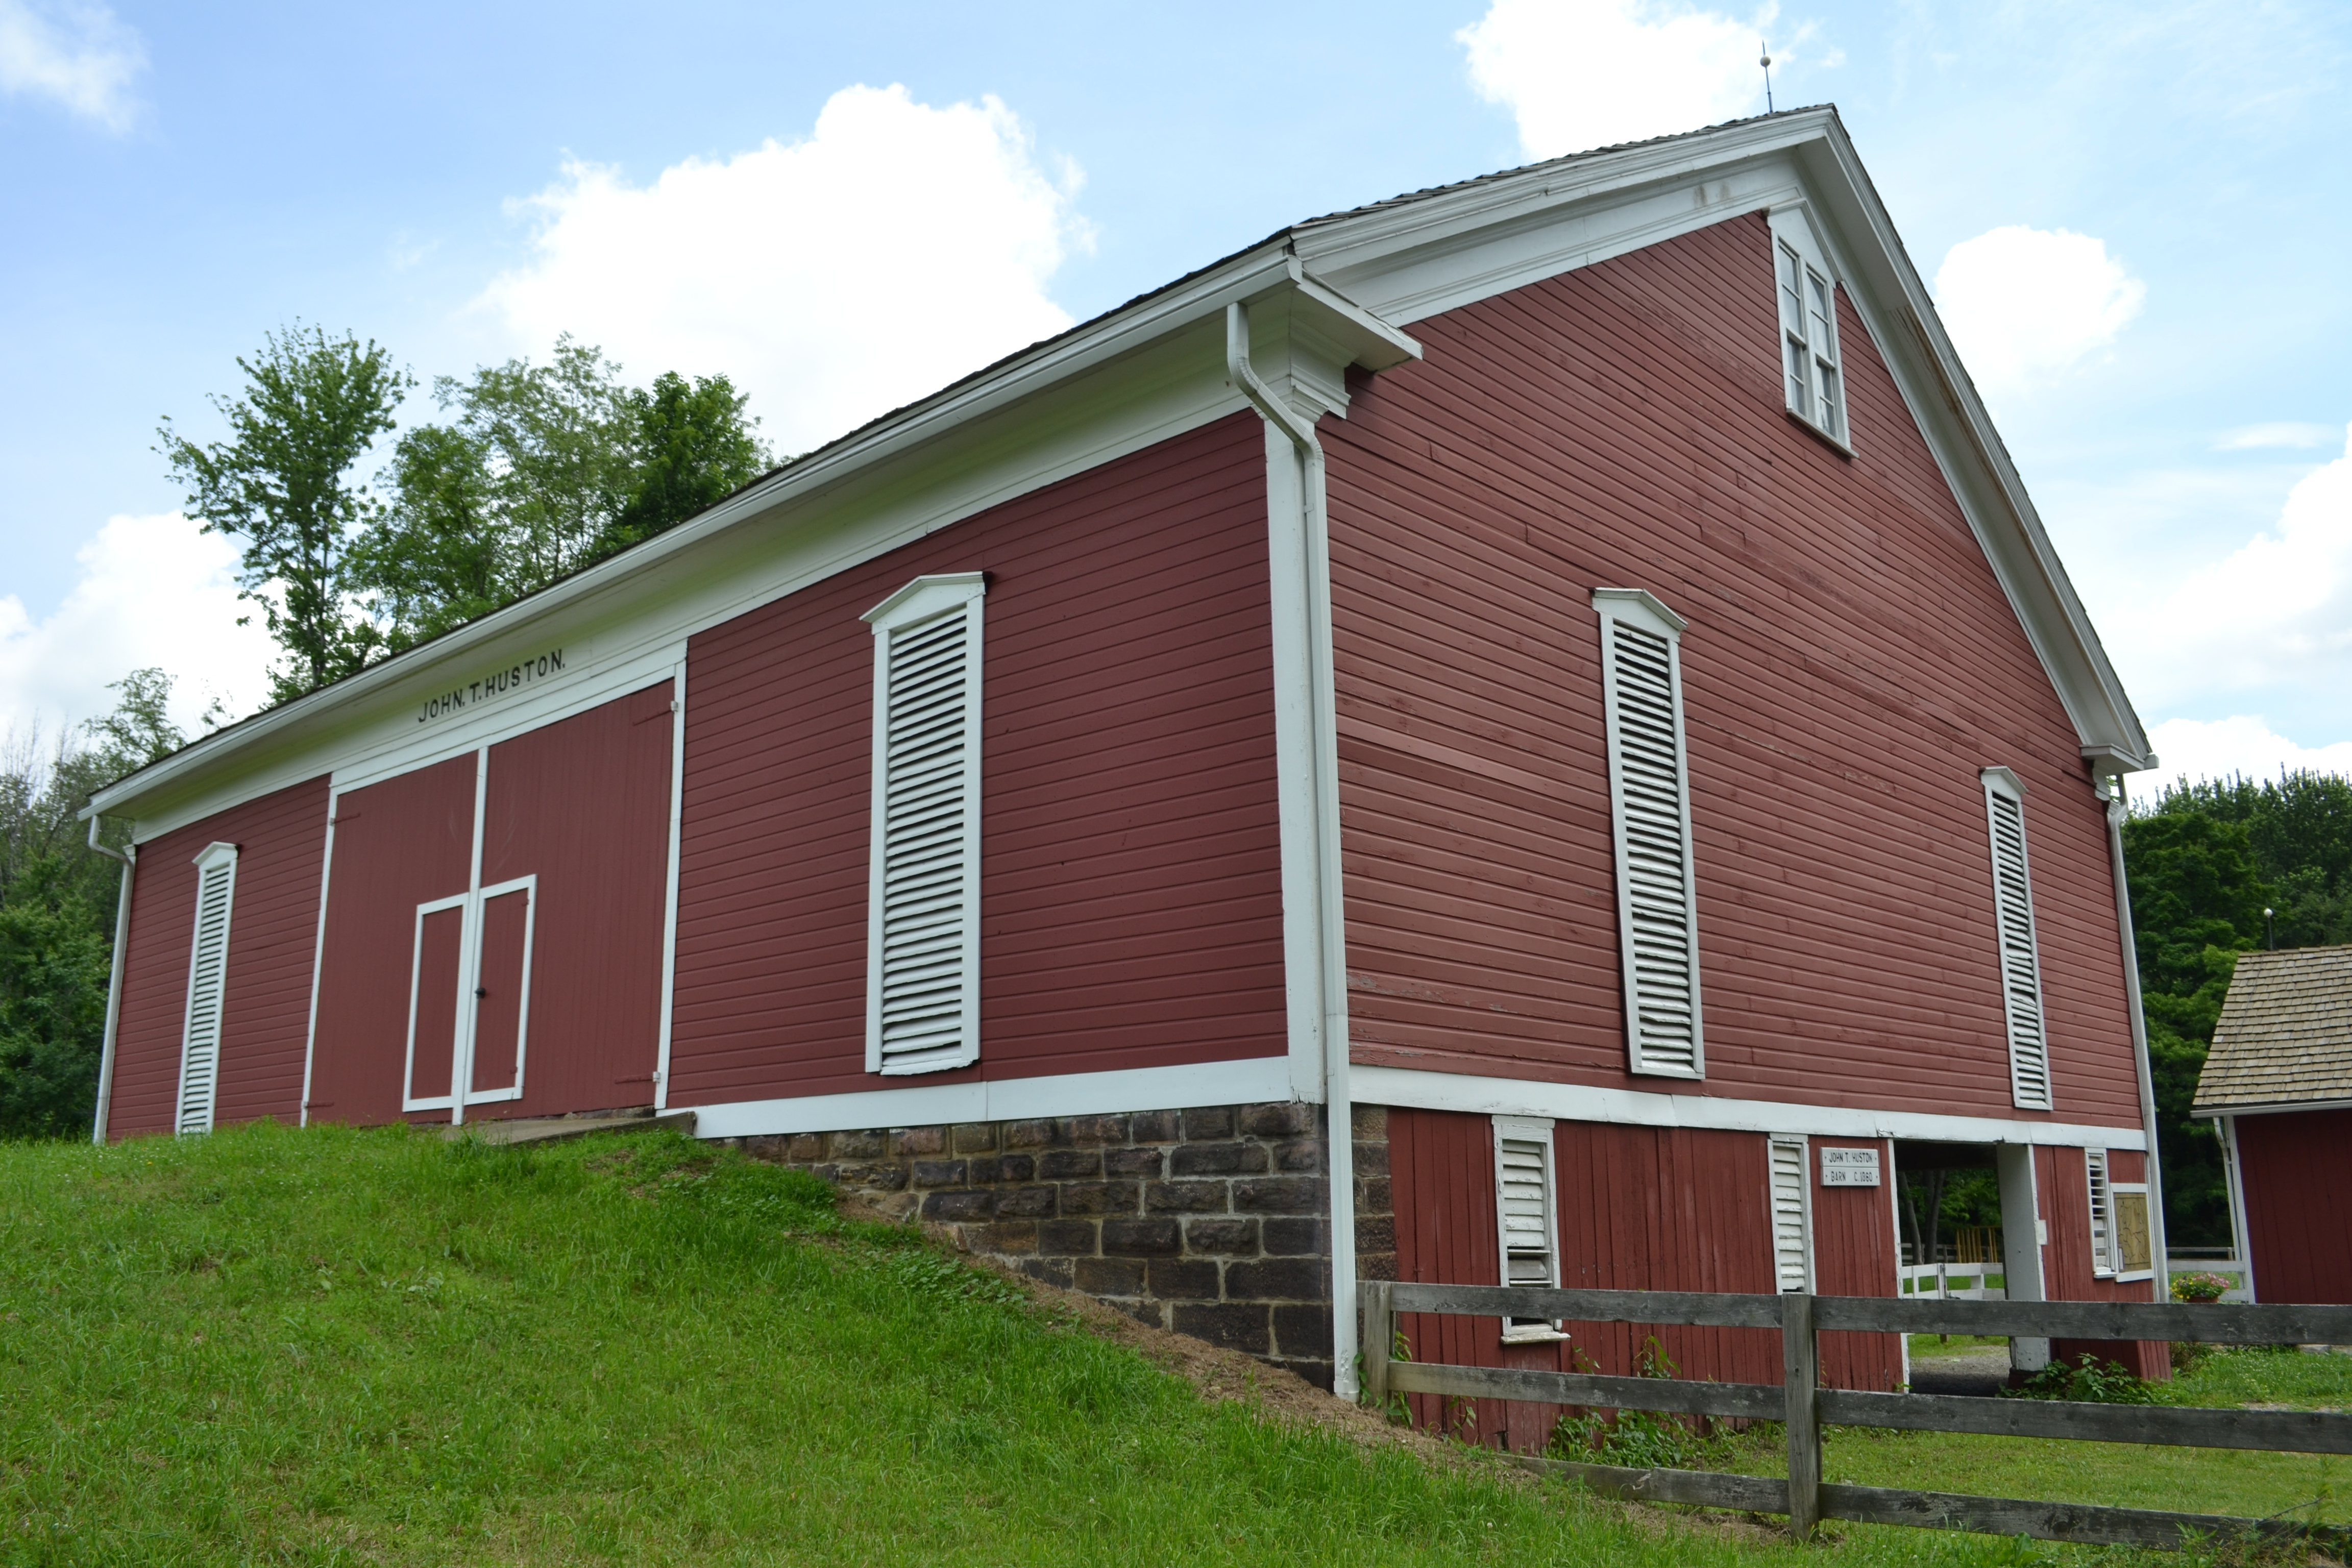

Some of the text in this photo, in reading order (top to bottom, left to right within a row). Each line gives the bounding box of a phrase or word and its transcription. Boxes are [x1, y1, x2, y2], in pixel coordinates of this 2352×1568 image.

[1829, 1152, 1873, 1163] JOHN T. HUSTON
[1831, 1171, 1846, 1182] BARN
